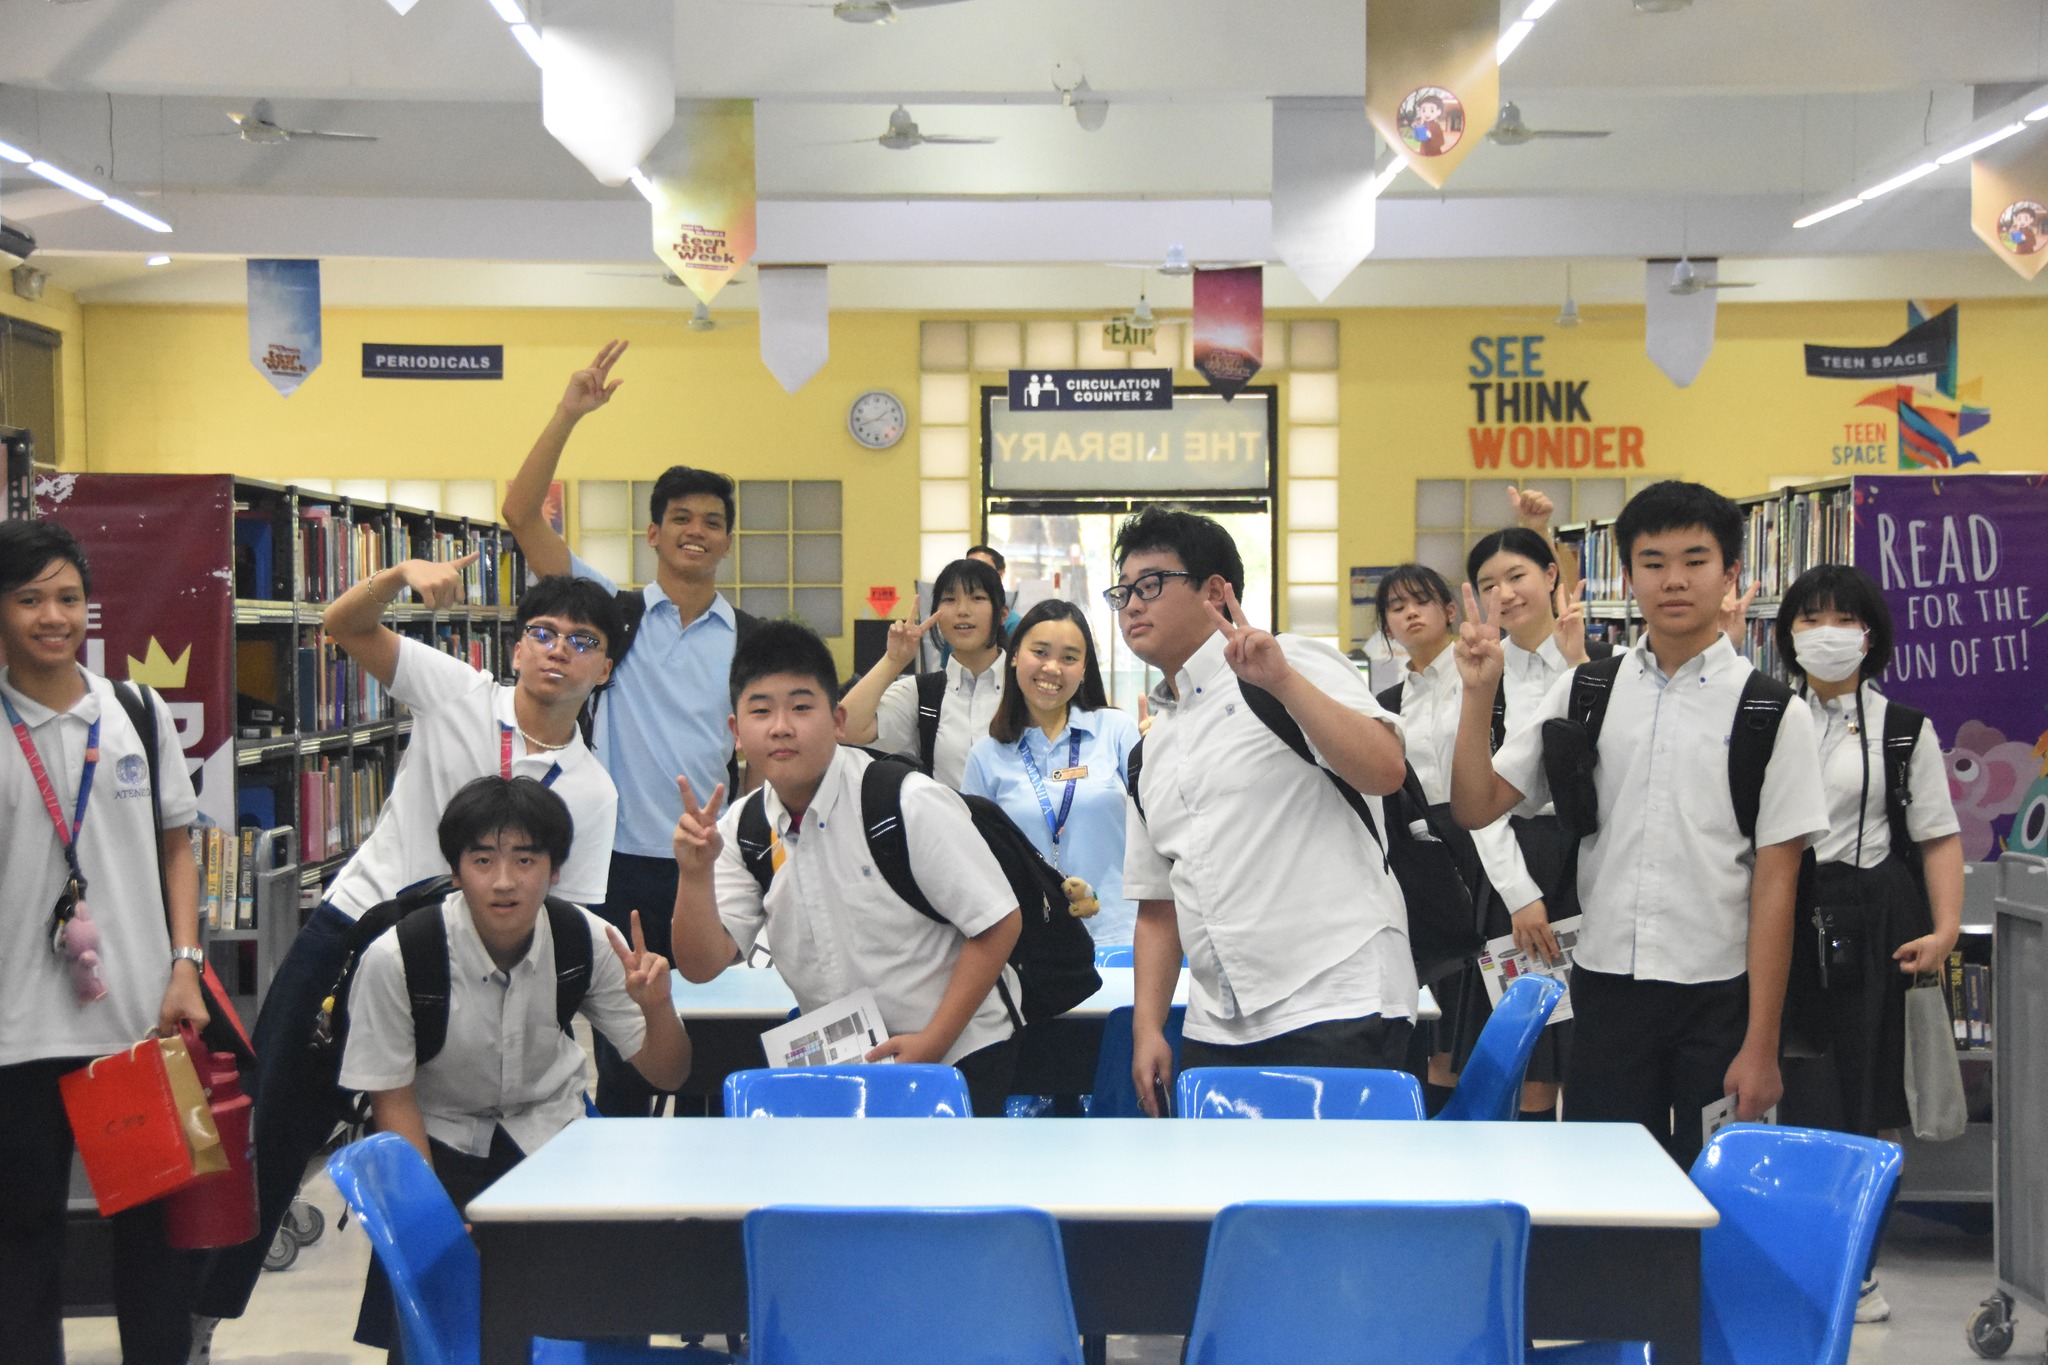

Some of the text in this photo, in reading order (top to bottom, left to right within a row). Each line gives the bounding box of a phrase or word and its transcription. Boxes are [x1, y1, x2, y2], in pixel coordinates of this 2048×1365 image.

[673, 243, 717, 254] read
[681, 233, 726, 247] teen
[678, 250, 736, 264] week
[1111, 317, 1146, 346] EXIT
[375, 354, 491, 369] PERIODICALS
[1468, 335, 1545, 378] SEE
[1821, 352, 1929, 369] TEEN SPACE
[1066, 378, 1161, 391] CIRCULATION
[1073, 391, 1154, 402] COUNTER 2
[1468, 381, 1592, 424] THINK
[1844, 423, 1887, 443] TEEN
[1468, 426, 1646, 470] WONDER
[1831, 445, 1887, 465] SPACE
[1877, 513, 1998, 590] READ
[1908, 586, 2032, 630] FOR THE
[1951, 638, 1981, 677] OF
[1992, 628, 2030, 673] IT!
[1024, 759, 1053, 815] MANILA
